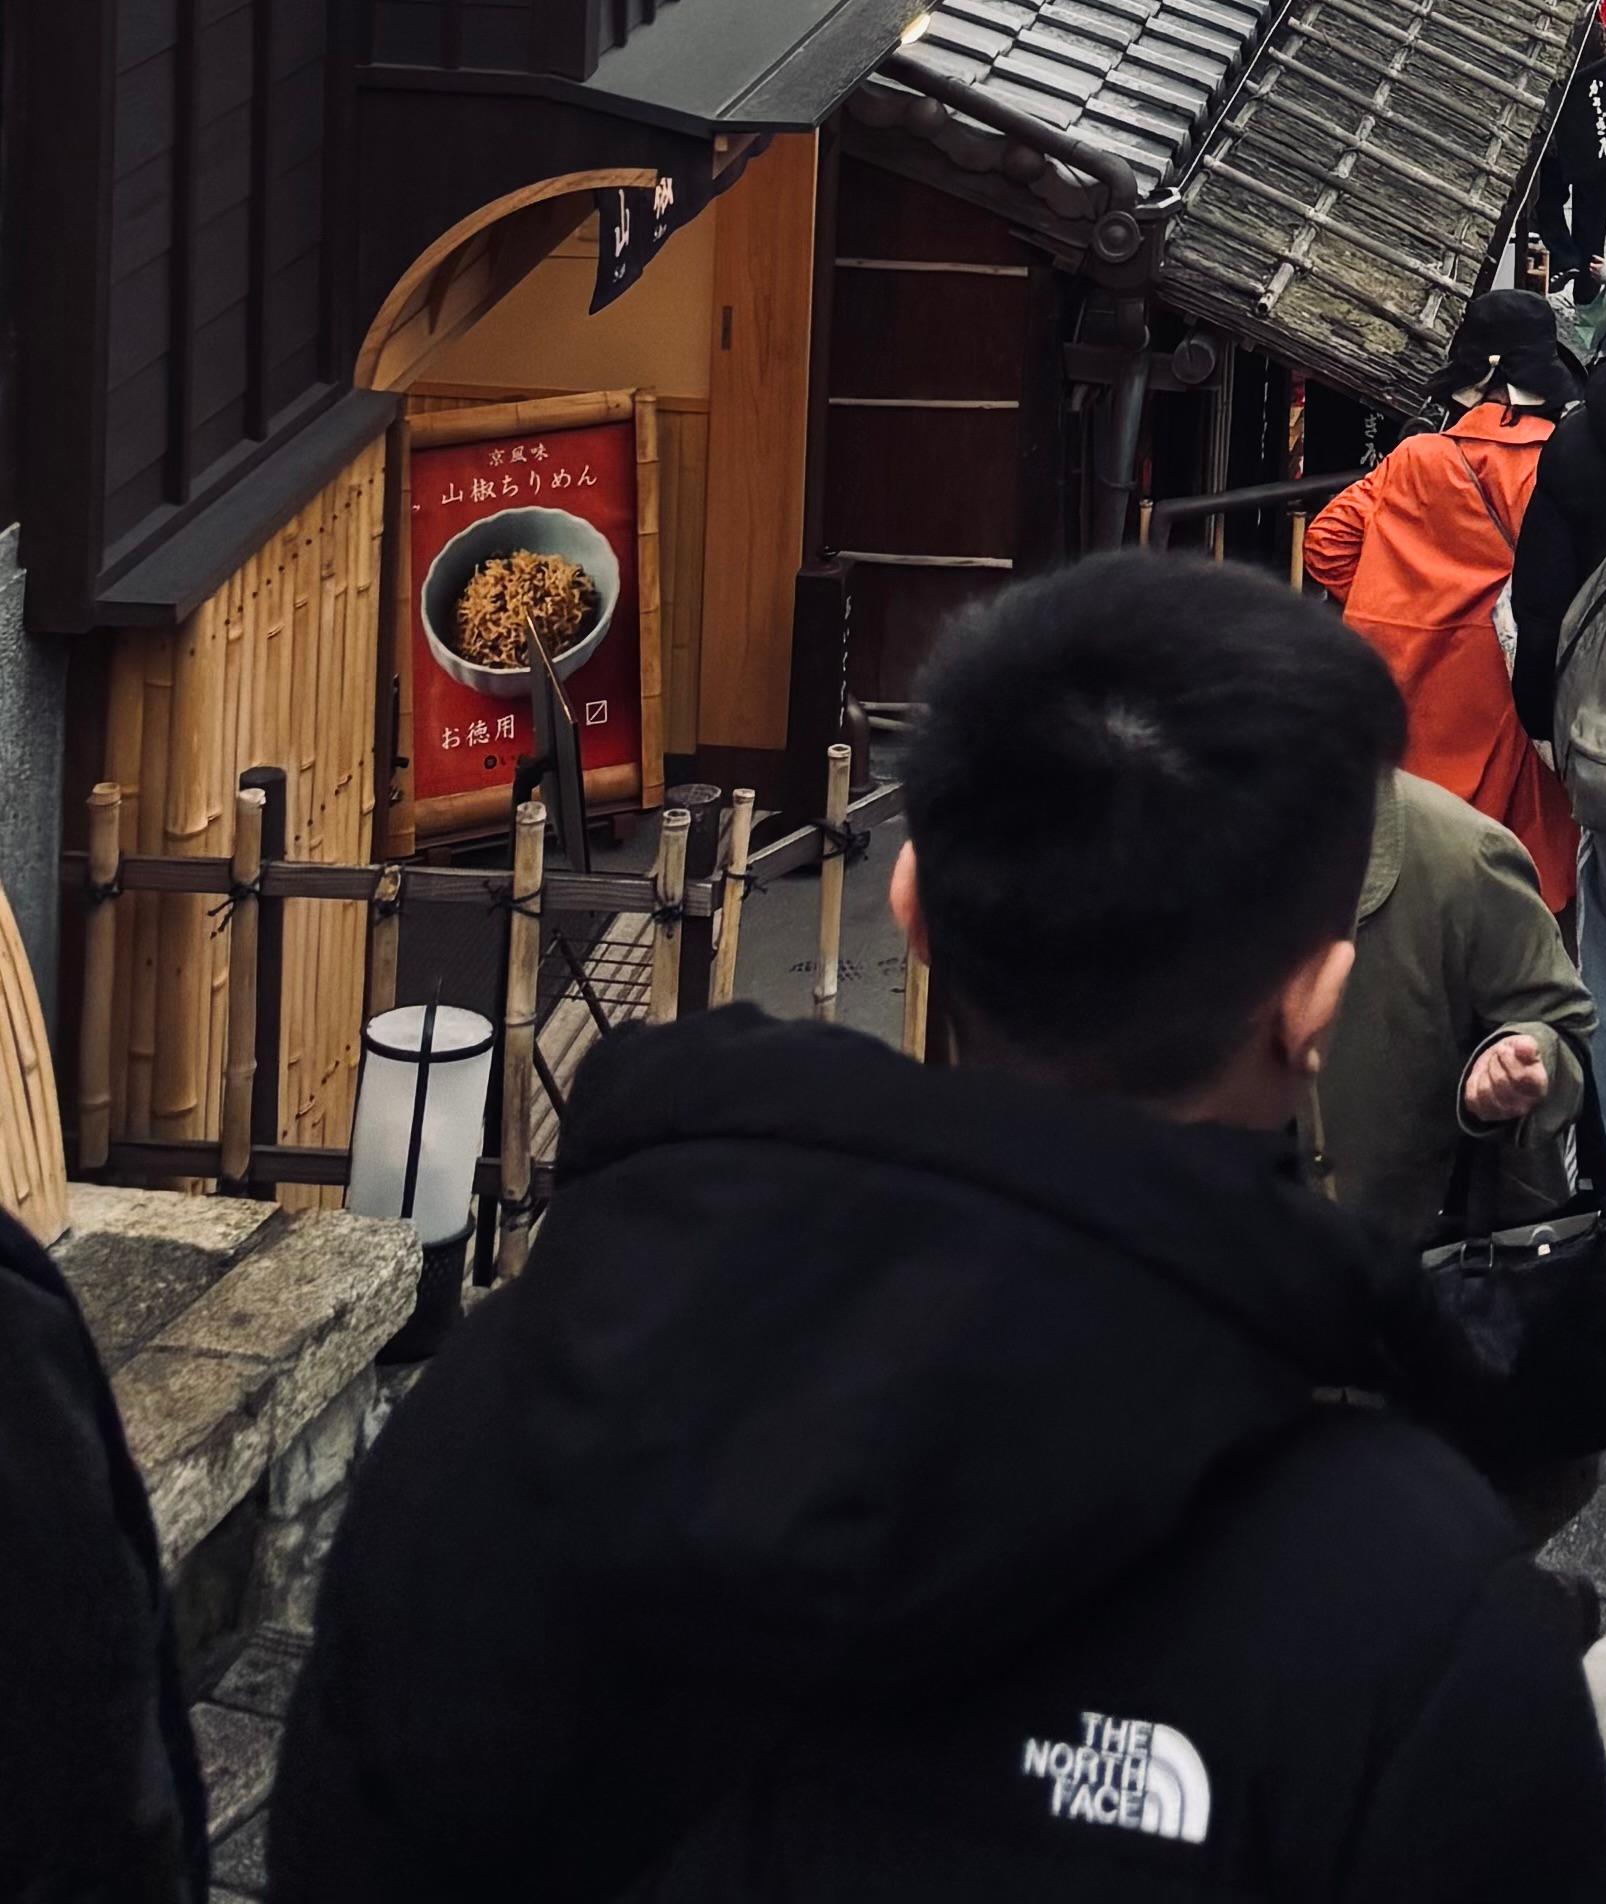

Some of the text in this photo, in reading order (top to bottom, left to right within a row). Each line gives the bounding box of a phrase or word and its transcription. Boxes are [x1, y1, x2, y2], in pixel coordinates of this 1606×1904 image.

[441, 464, 598, 505] 山椒ちりめん
[1081, 1711, 1152, 1756] THE
[1023, 1737, 1148, 1797] NORTH
[1051, 1776, 1144, 1829] FACE
